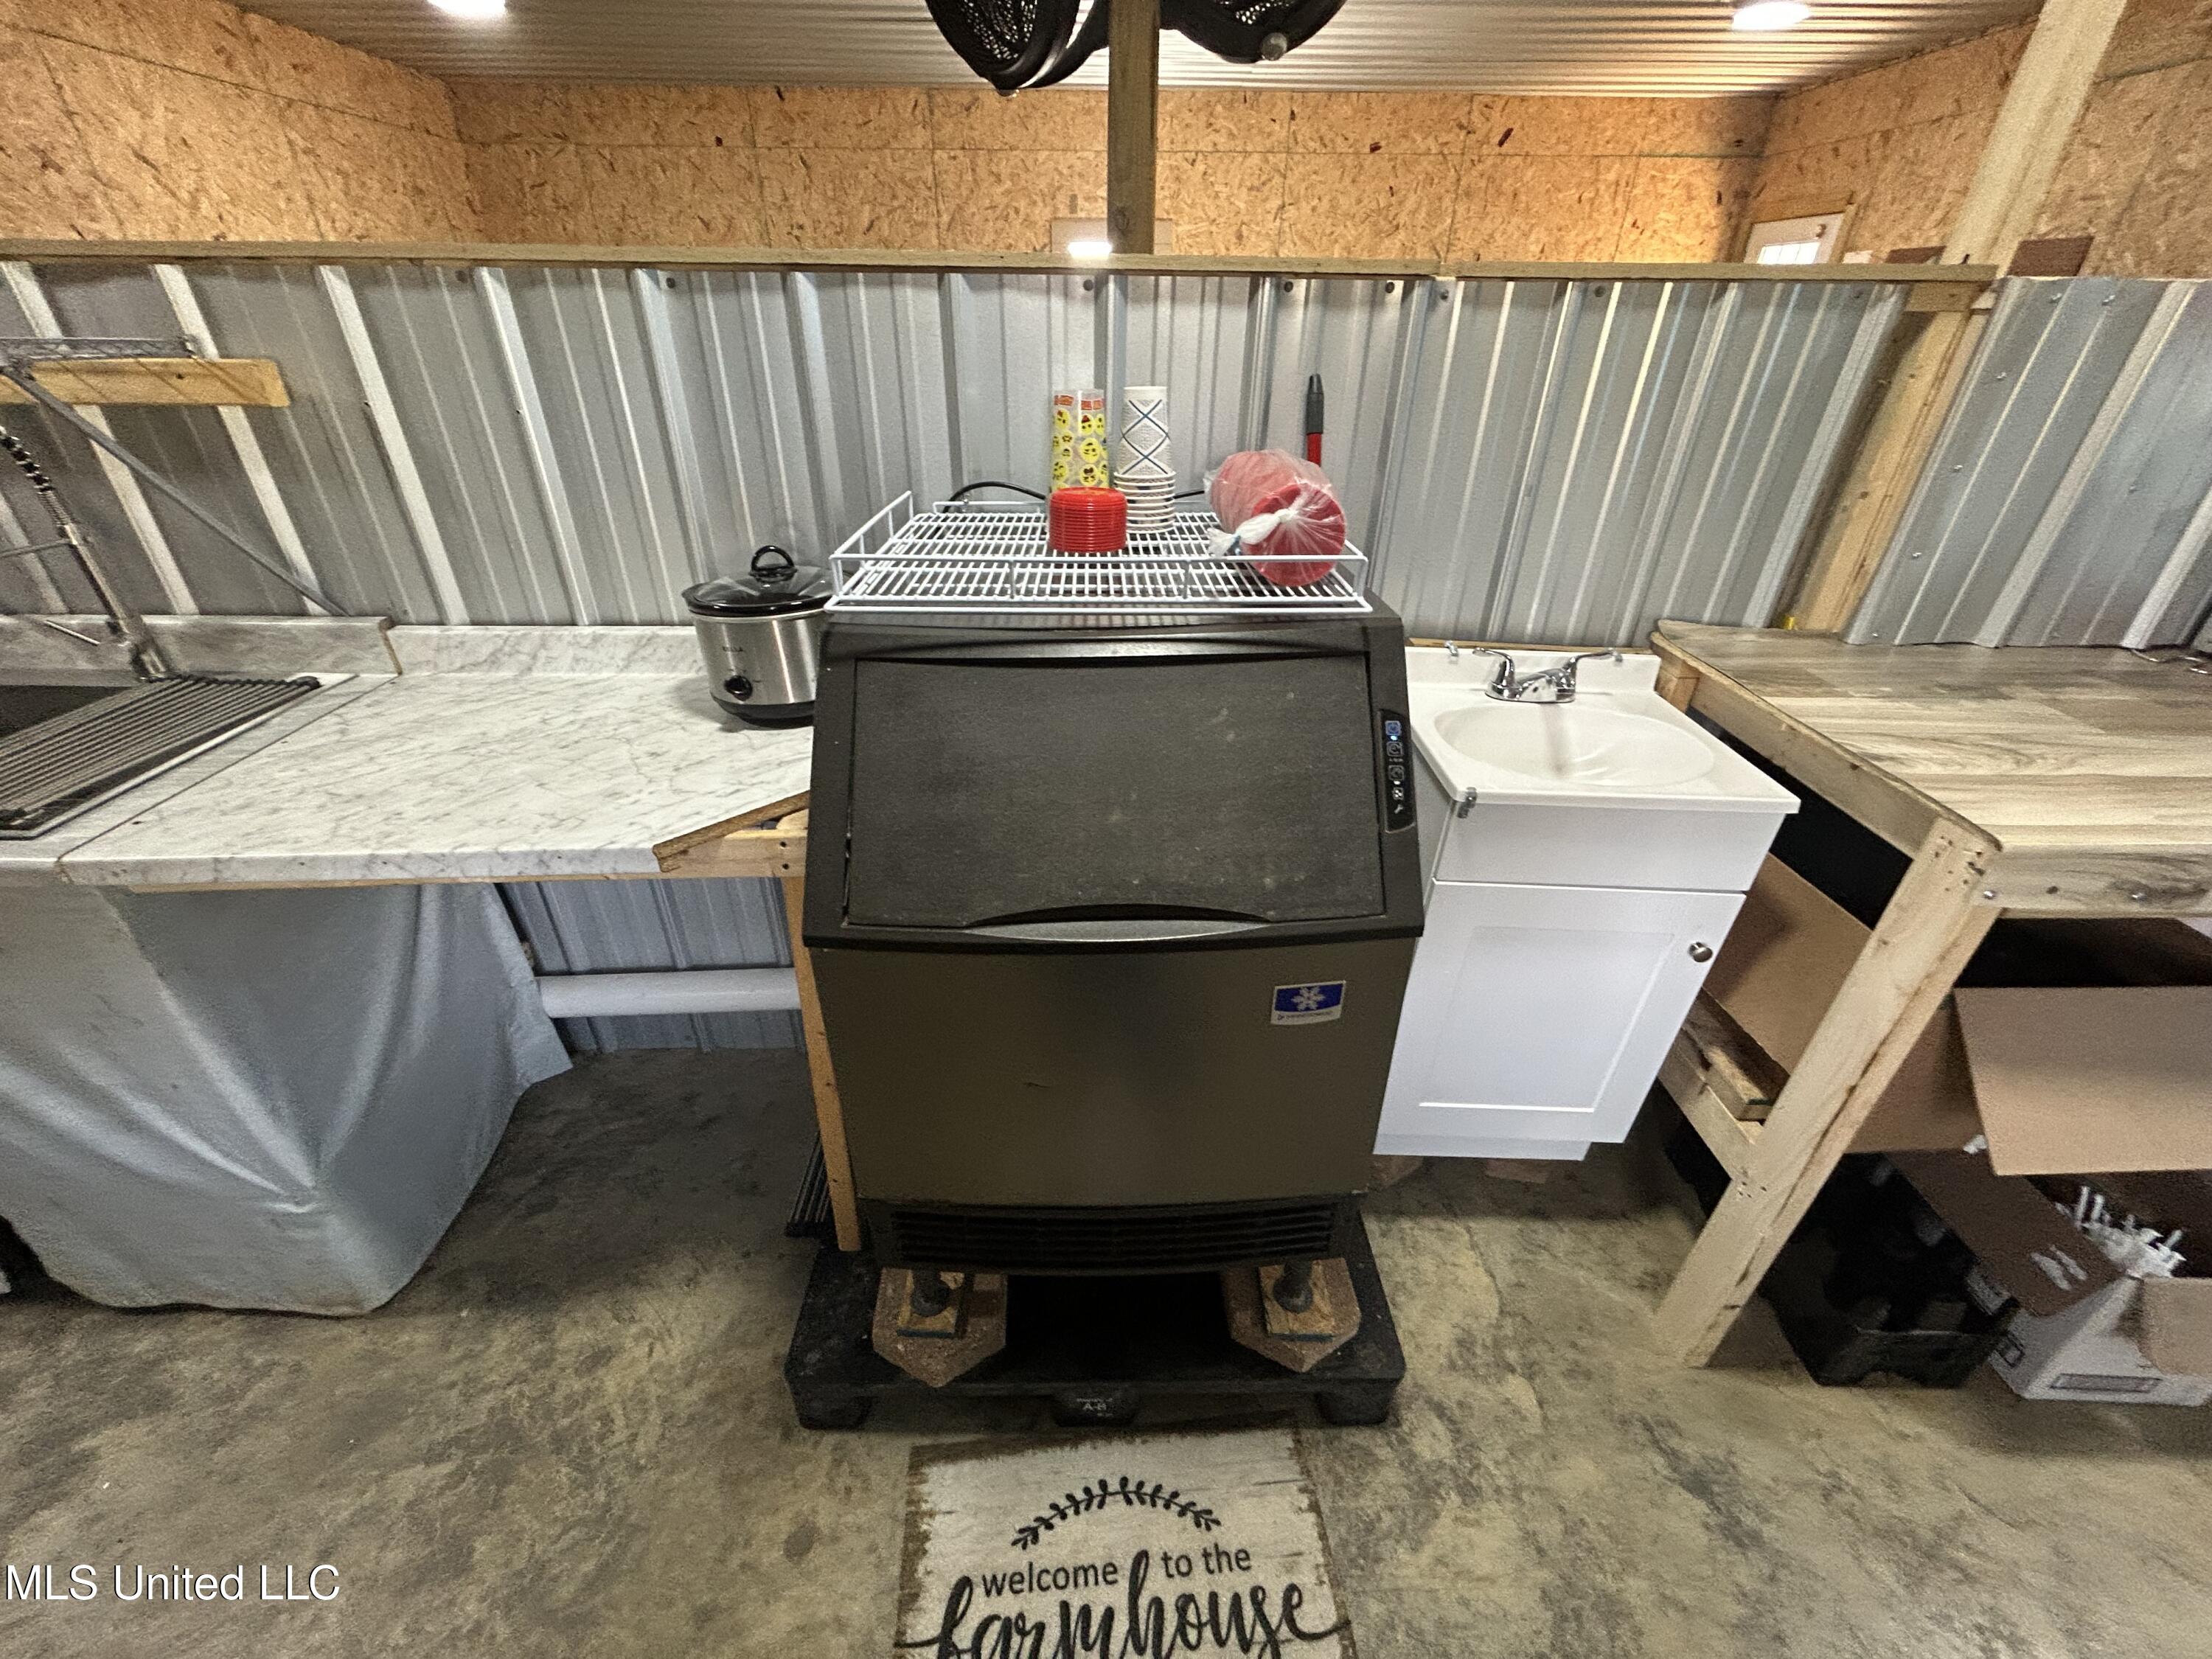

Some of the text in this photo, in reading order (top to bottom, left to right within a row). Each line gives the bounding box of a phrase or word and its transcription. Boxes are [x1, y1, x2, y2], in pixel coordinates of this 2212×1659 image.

[894, 1549, 1352, 1659] farmhouse
[982, 1543, 1251, 1598] welcome to the
